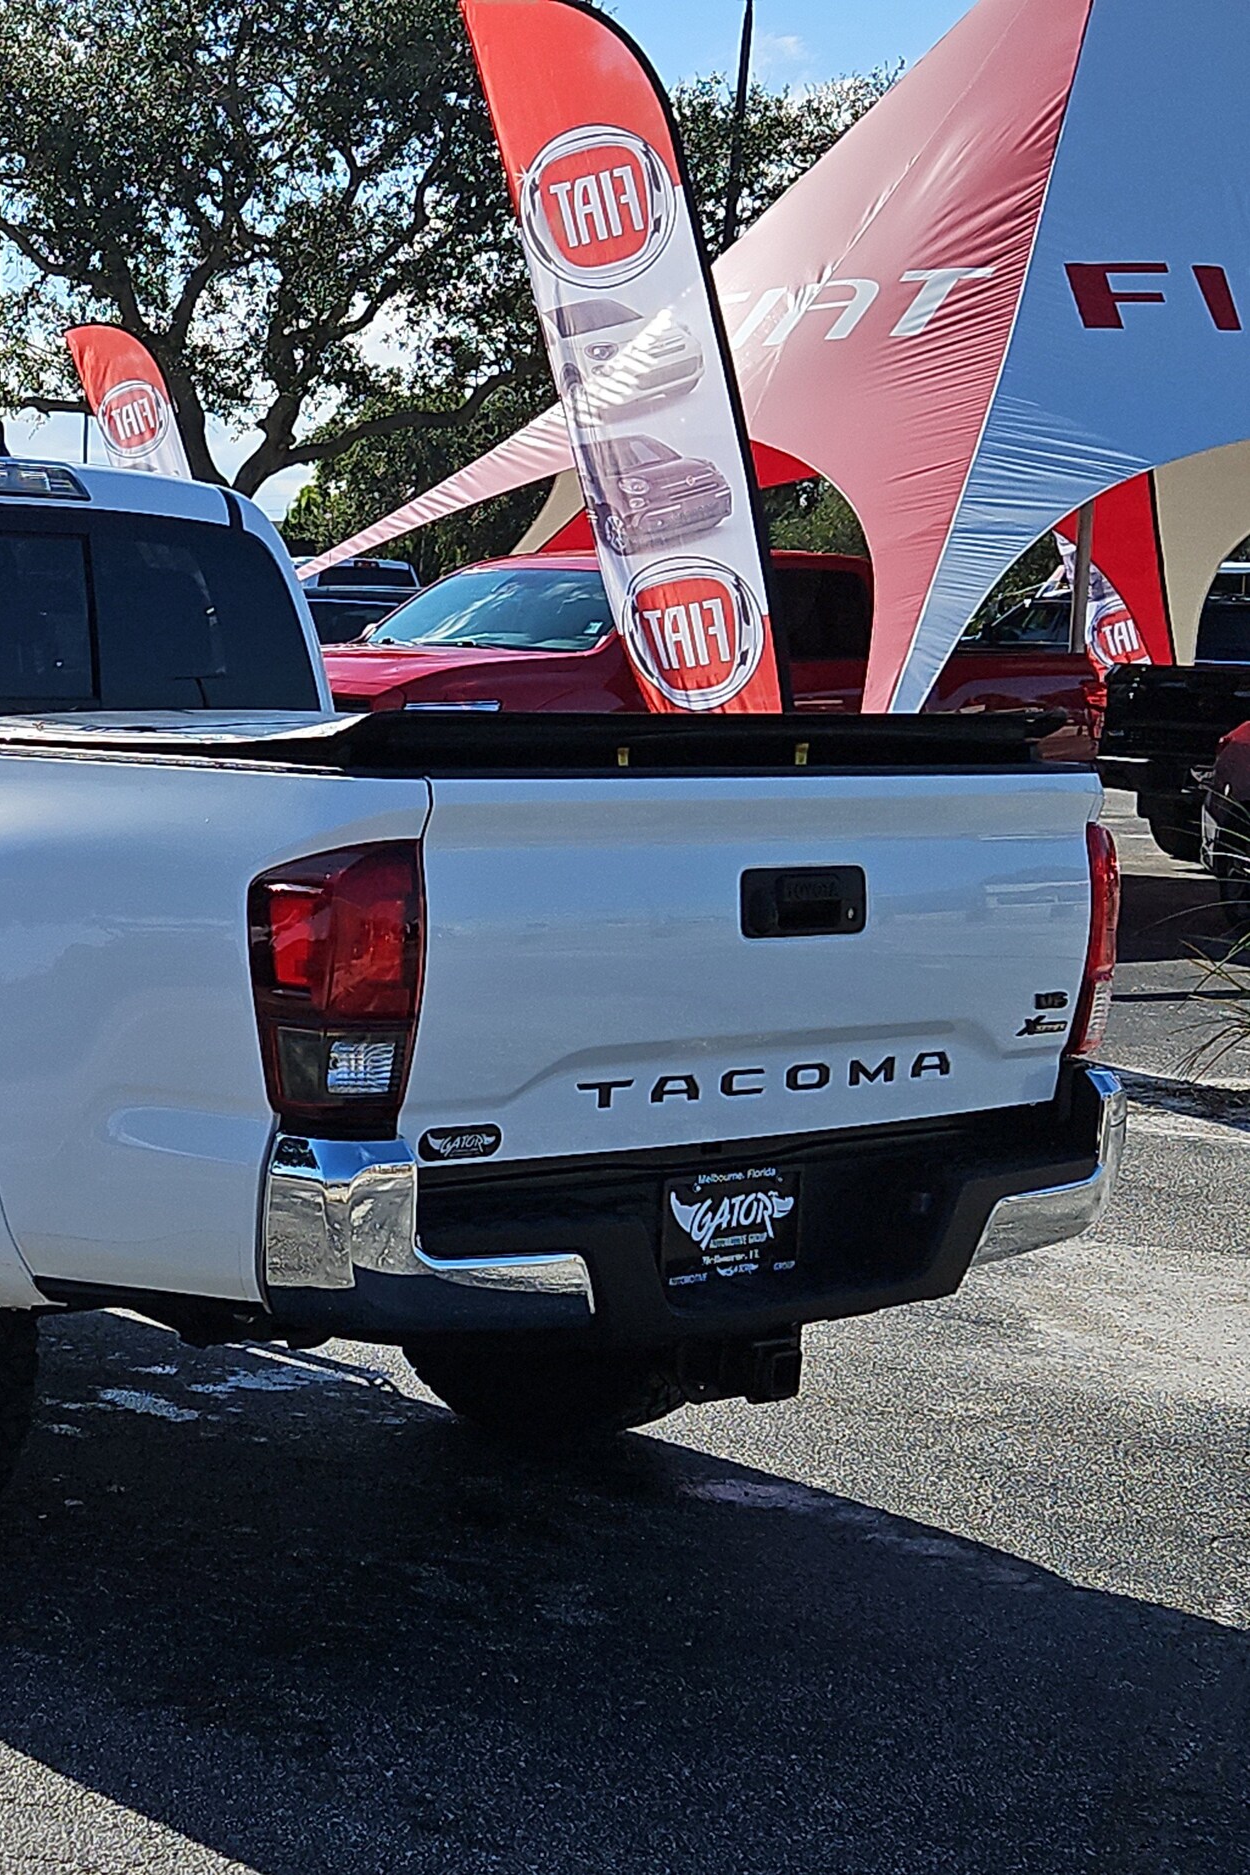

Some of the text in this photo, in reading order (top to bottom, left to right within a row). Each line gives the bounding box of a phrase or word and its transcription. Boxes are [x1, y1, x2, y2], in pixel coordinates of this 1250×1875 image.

[721, 267, 998, 350] IAT
[576, 1051, 950, 1109] TACOMA
[440, 1133, 484, 1157] GATOR
[747, 1167, 776, 1179] Florida
[691, 1191, 774, 1251] GATOR
